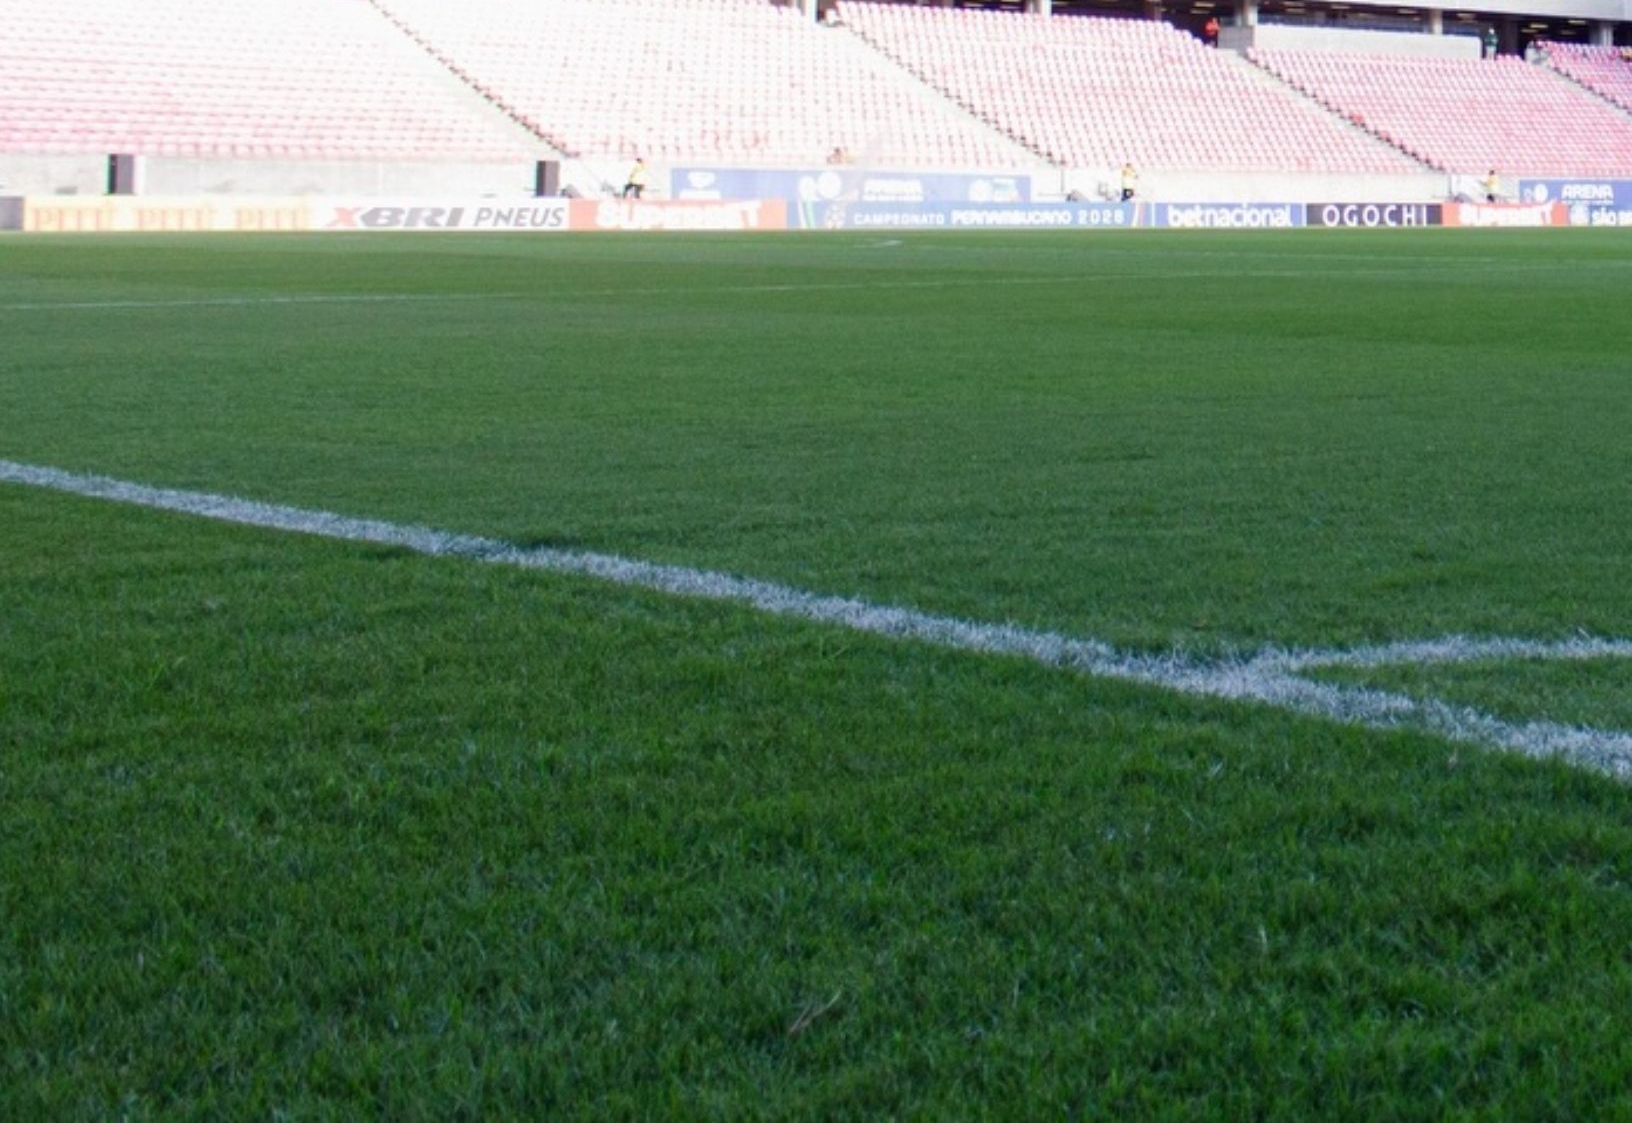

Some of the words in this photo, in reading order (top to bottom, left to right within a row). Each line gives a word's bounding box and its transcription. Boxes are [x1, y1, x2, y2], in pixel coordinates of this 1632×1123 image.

[1561, 184, 1614, 198] ARENA
[326, 207, 464, 227] XBRI
[473, 207, 565, 227] PNEUS
[854, 213, 945, 226] CAMPEONATO
[950, 209, 1073, 225] PERNAMBUCANO
[1168, 204, 1292, 226] betnacional
[1322, 205, 1427, 226] OGOCHI
